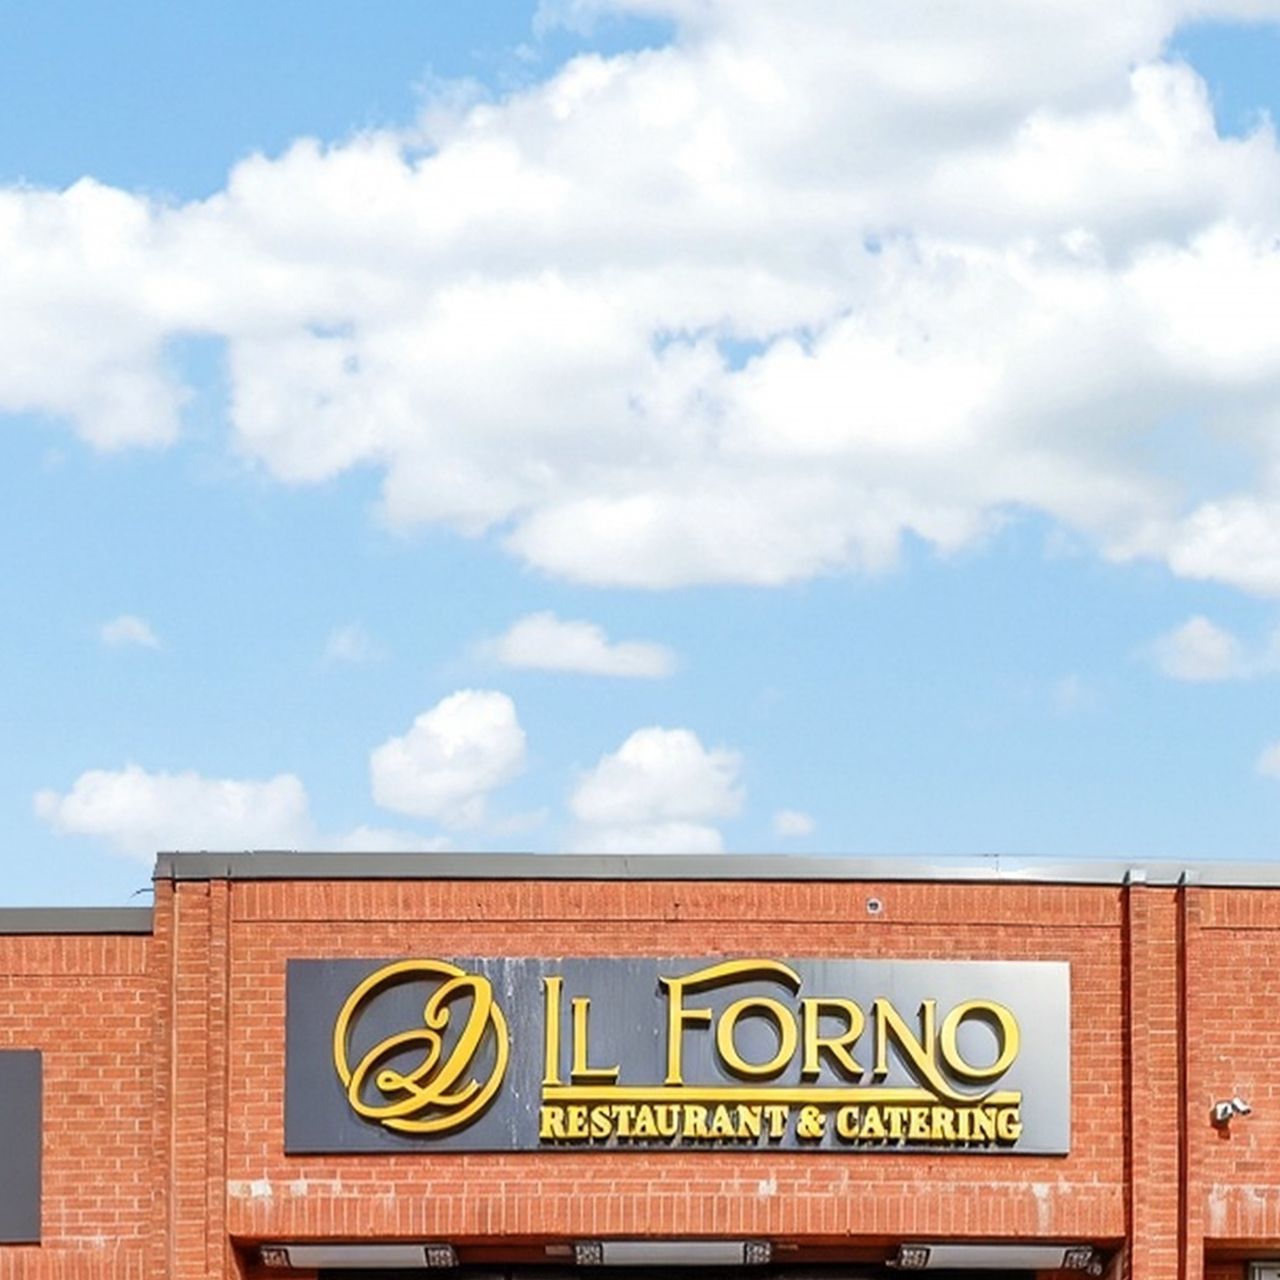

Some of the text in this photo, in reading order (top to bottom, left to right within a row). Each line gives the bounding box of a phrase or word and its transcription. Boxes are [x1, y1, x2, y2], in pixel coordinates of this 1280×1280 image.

[539, 1104, 1022, 1140] RESTAURANT & CATERING
